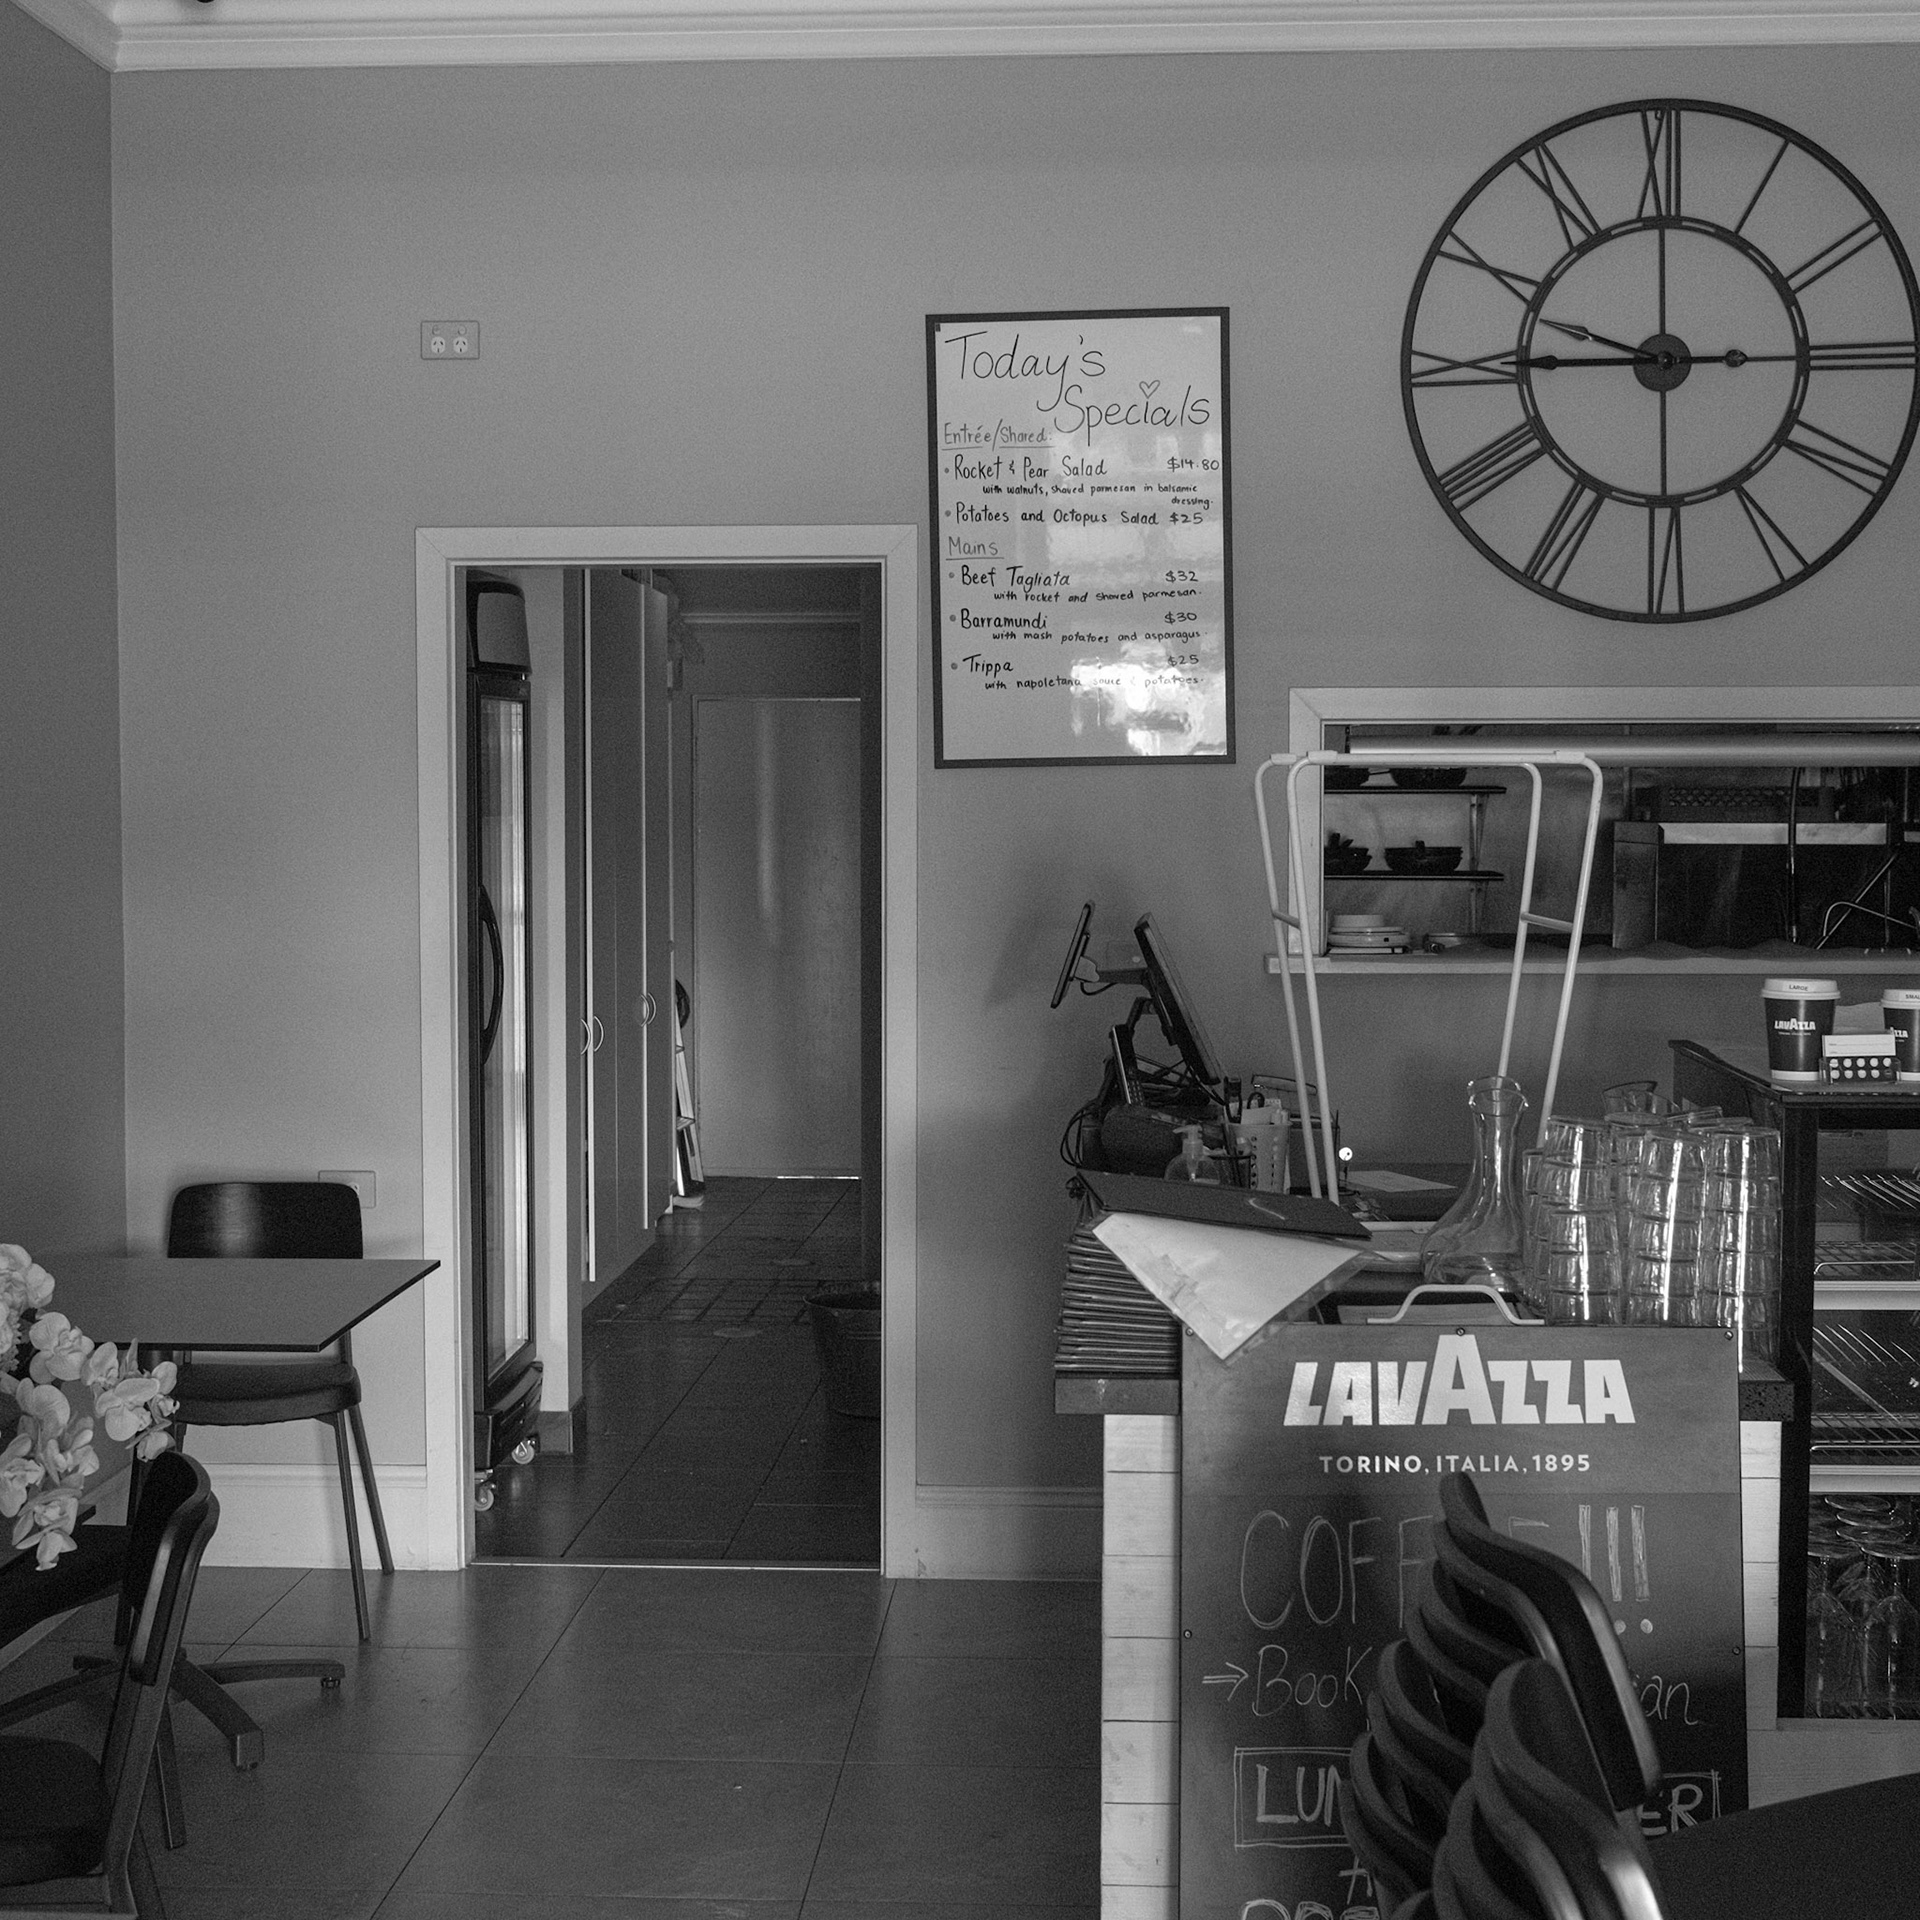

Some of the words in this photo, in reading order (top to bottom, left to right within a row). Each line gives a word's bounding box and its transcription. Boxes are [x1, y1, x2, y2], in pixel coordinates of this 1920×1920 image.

[945, 331, 1106, 411] Today's
[1054, 384, 1210, 446] Specials
[955, 453, 1003, 480] Rocket
[1023, 456, 1049, 481] Pear
[1062, 455, 1107, 477] Salad
[1167, 456, 1220, 473] $14.80
[982, 484, 1003, 495] with
[1051, 483, 1084, 494] shaved
[1090, 485, 1136, 497] parmesan
[1143, 483, 1153, 492] in
[1158, 483, 1198, 493] balsamic
[956, 501, 1010, 524] Potatoes
[1020, 509, 1045, 522] and
[1053, 508, 1108, 527] Octopus
[1120, 510, 1160, 525] Salad
[1169, 511, 1203, 525] $25
[948, 536, 999, 556] Mains
[961, 564, 997, 587] Beef
[1006, 565, 1071, 594] Tagliata
[1165, 570, 1199, 583] $32
[994, 590, 1018, 600] with
[1025, 591, 1061, 602] rocket
[1068, 592, 1089, 603] and
[960, 607, 1048, 629] Barramundi
[1164, 611, 1198, 625] $30
[992, 630, 1017, 640] with
[1023, 631, 1053, 640] mash
[1060, 631, 1109, 645] potatoes
[1117, 631, 1137, 642] and
[962, 653, 1013, 678] Trippa
[1167, 654, 1199, 667] $25
[985, 680, 1007, 690] with
[1016, 675, 1082, 690] napoletana
[1774, 1018, 1816, 1030] LAVAZZA
[1283, 1334, 1636, 1426] LAVAZZA
[1319, 1455, 1430, 1475] TORINO,
[1532, 1454, 1591, 1473] 1895
